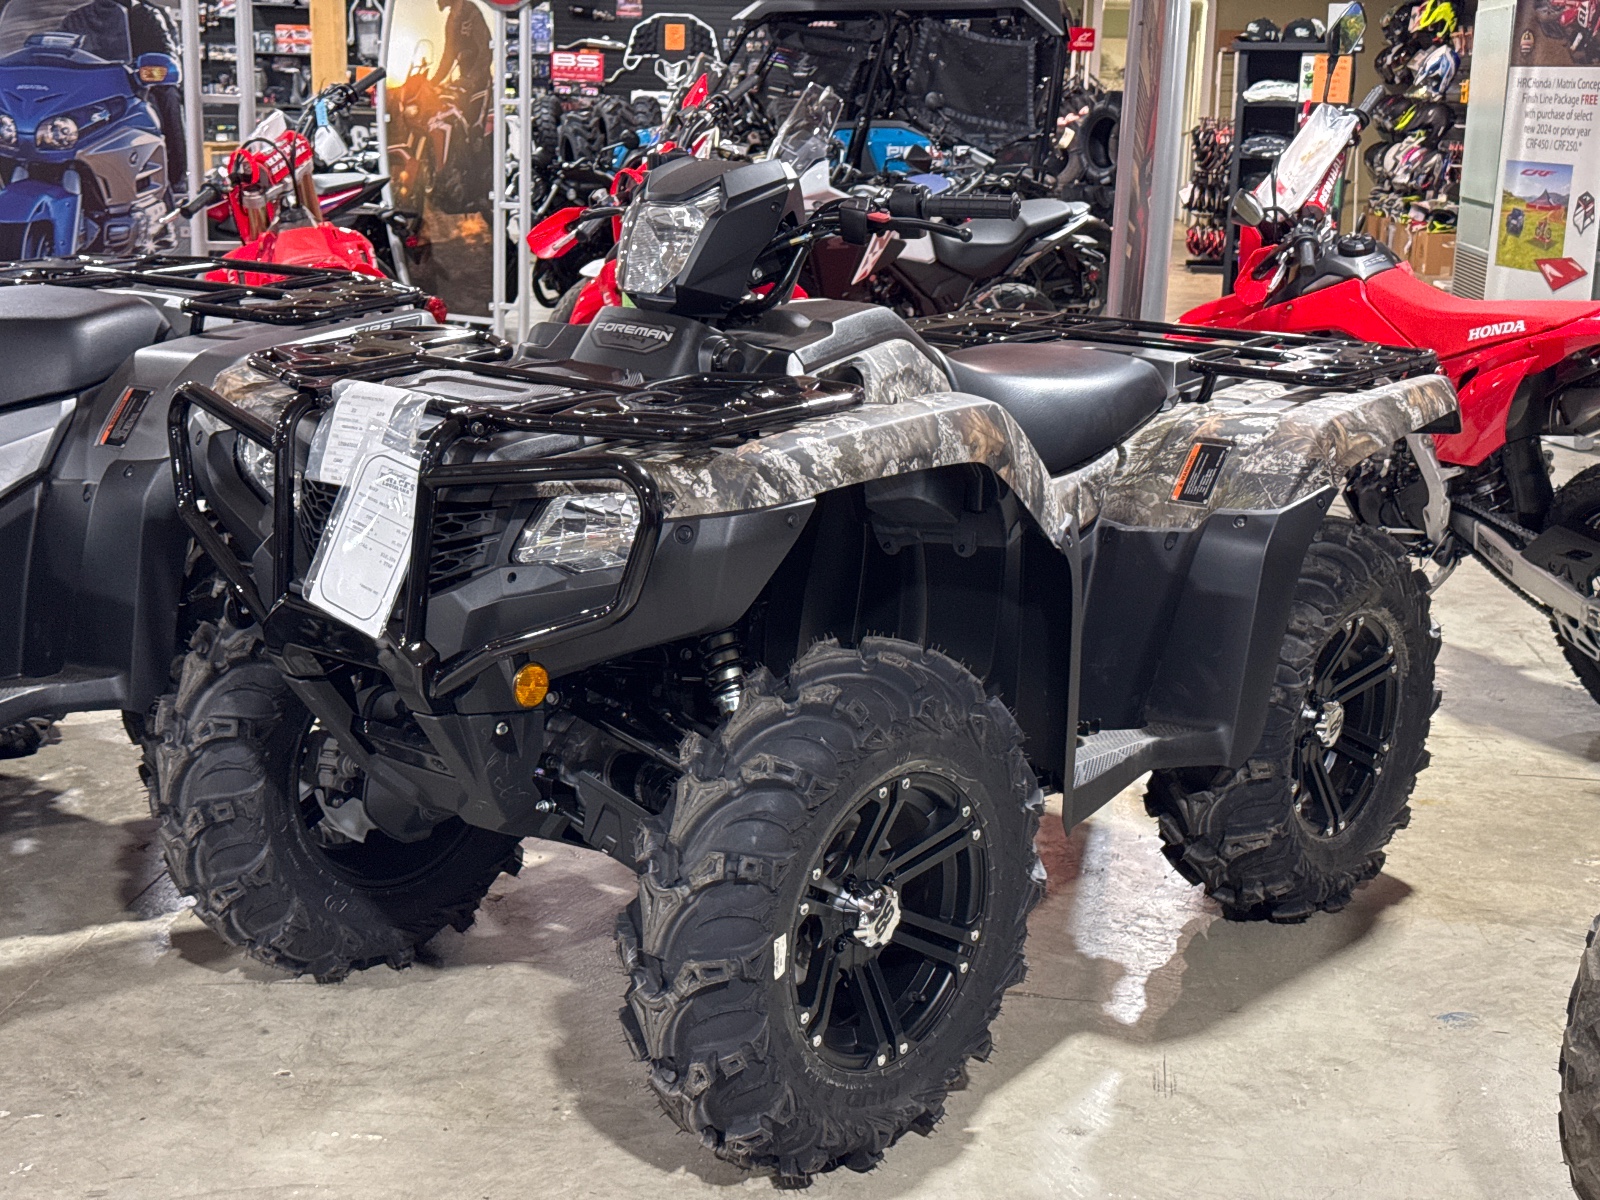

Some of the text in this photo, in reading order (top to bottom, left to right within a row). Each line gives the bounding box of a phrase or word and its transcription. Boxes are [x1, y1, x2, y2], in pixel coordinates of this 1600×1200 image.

[553, 53, 600, 67] BS
[1556, 78, 1576, 89] Matrix
[1540, 93, 1553, 104] Line
[1554, 94, 1580, 107] Package
[1581, 94, 1598, 105] FREE
[1536, 109, 1565, 121] purchase
[1566, 109, 1573, 120] of
[1573, 110, 1593, 121] select
[1536, 124, 1552, 134] 2024
[1552, 127, 1559, 135] or
[1560, 126, 1576, 137] prior
[1576, 128, 1592, 139] year
[1525, 138, 1549, 150] CRF450
[1521, 168, 1557, 177] CRF
[1318, 157, 1343, 207] RENTHAL
[594, 322, 674, 342] FOREMAN
[1467, 320, 1526, 341] HONDA
[1180, 455, 1196, 480] WARNING
